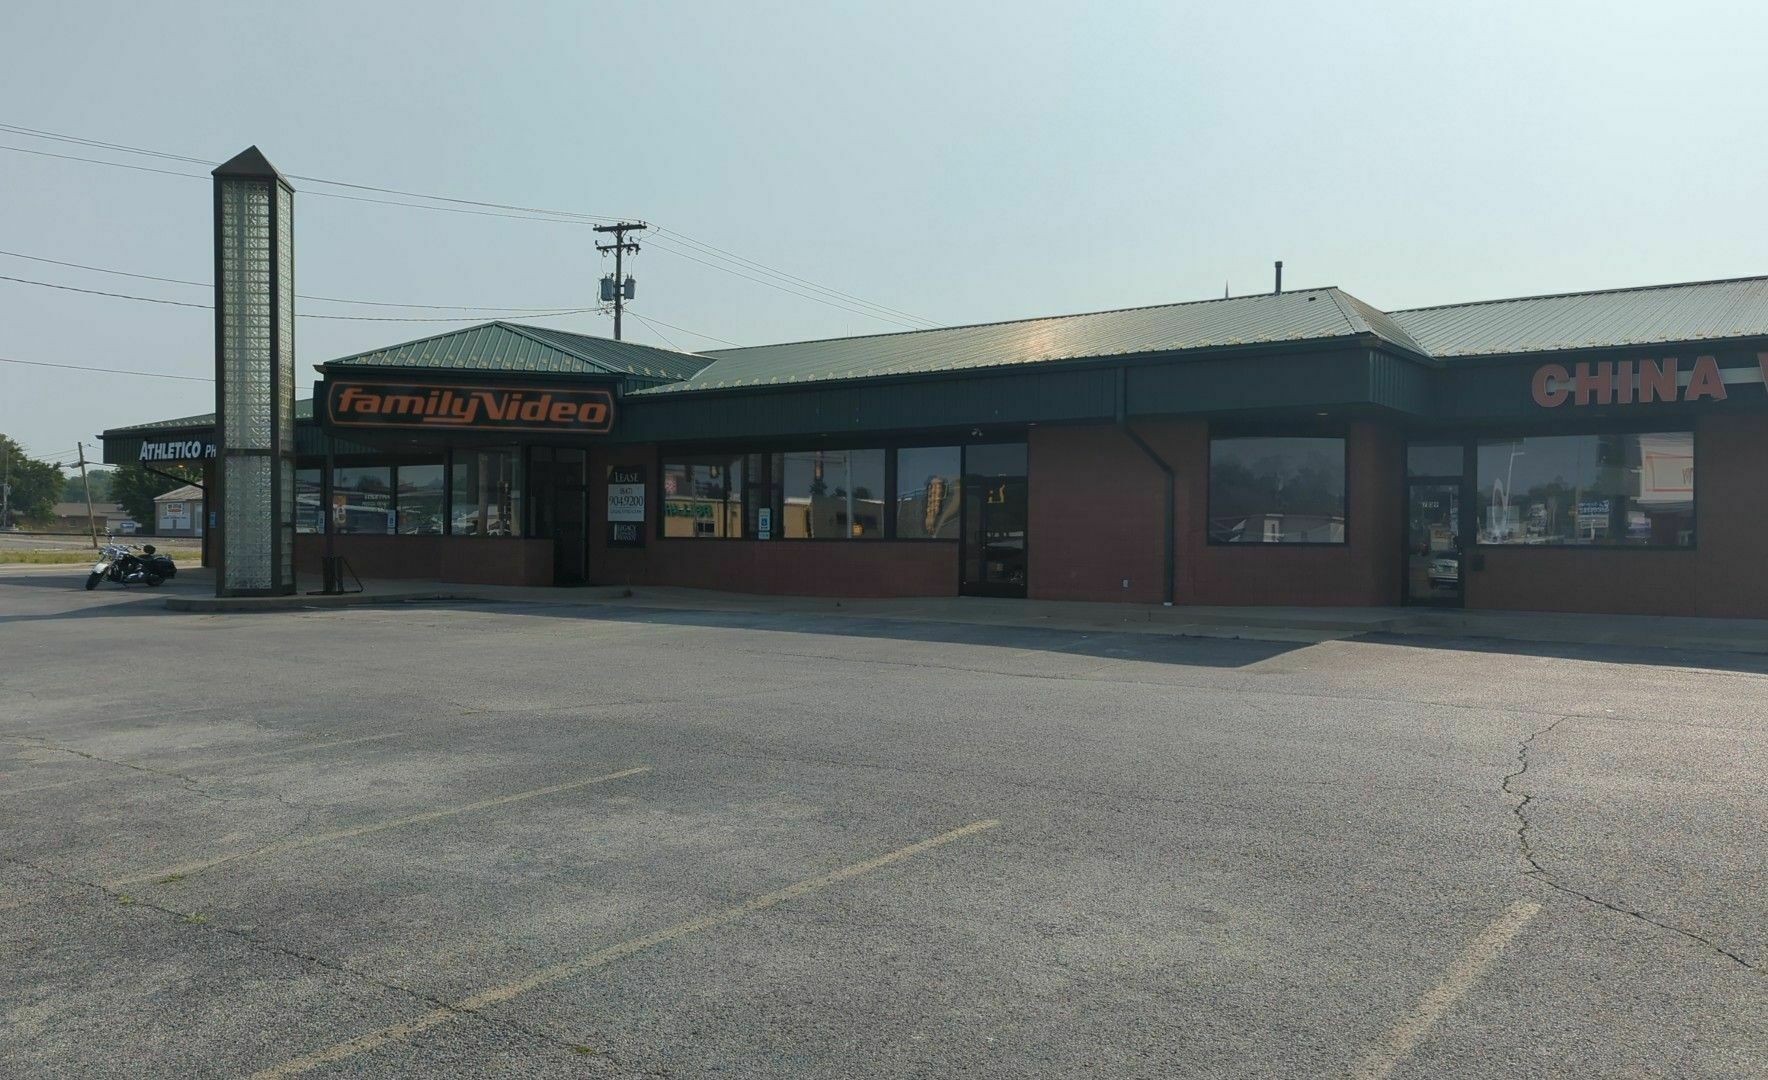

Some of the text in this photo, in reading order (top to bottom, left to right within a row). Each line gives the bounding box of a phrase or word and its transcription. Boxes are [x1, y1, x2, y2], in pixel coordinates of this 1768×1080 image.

[1531, 355, 1727, 408] CHINA
[139, 440, 201, 461] ATHLETICO
[615, 472, 639, 483] LEASE
